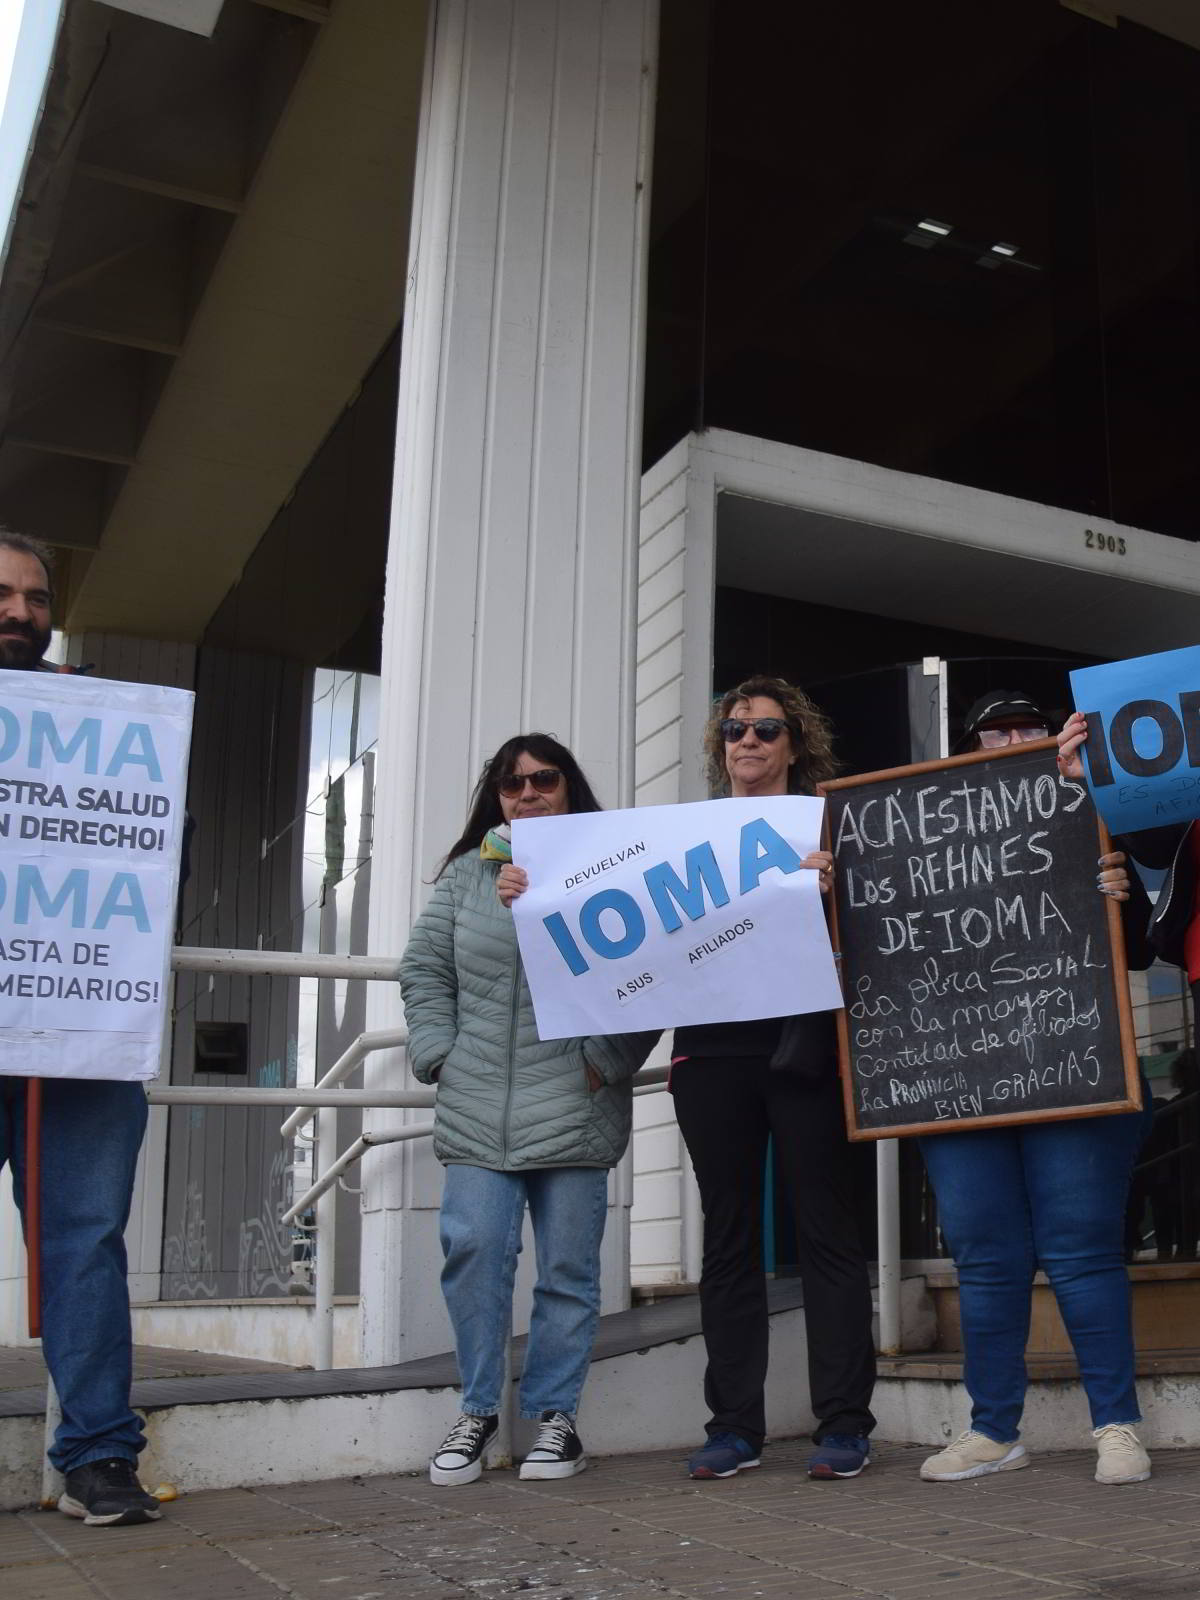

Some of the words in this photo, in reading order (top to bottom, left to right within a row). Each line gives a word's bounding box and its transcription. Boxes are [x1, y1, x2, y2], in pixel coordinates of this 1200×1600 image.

[1085, 529, 1127, 556] 2903
[76, 787, 170, 819] SALUD
[1118, 784, 1150, 805] ES
[20, 817, 165, 852] DERECHO!
[565, 841, 646, 889] DEVUELVAN
[908, 830, 1053, 898] REHNES
[0, 864, 153, 934] MA
[542, 817, 803, 977] IOMA
[73, 942, 110, 967] DE
[688, 918, 755, 965] AFILIADOS
[616, 988, 626, 1001] A
[626, 972, 654, 994] SUS
[911, 1008, 946, 1034] la
[972, 1028, 1004, 1055] de
